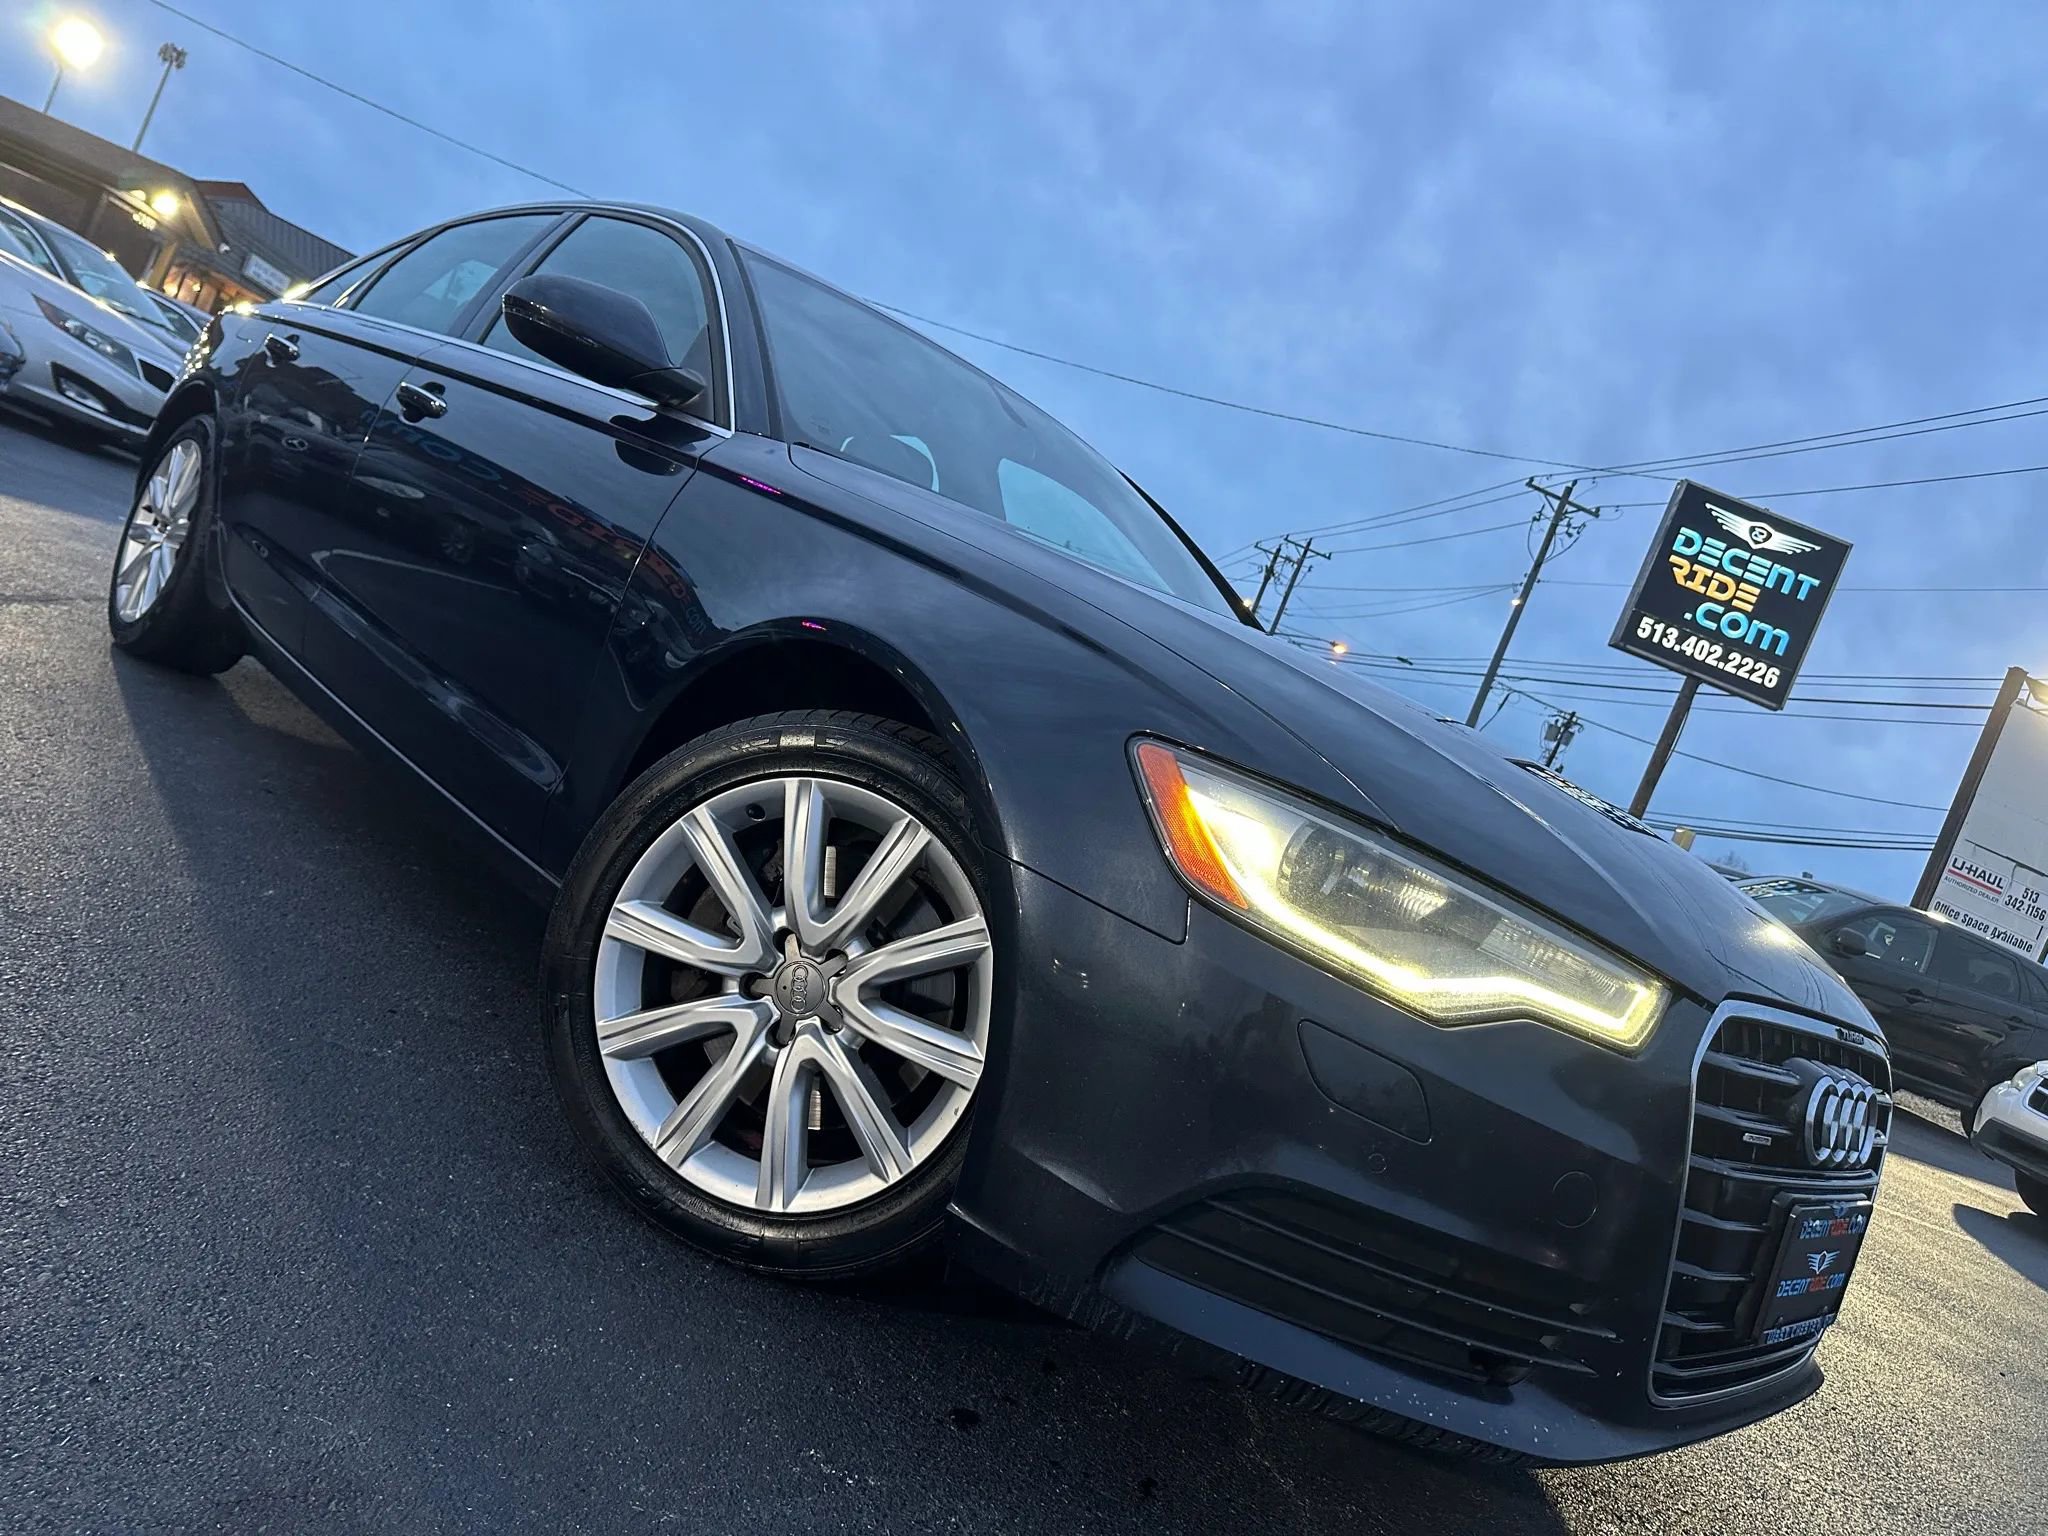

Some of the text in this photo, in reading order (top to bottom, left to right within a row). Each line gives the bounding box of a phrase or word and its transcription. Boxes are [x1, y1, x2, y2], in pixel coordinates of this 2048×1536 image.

[1672, 526, 1820, 600] DECENT
[1668, 554, 1761, 612] RIDE
[1636, 616, 1781, 689] 513.402.2226
[1943, 875, 2000, 904] AUTHORIZED DEALER
[1951, 857, 2004, 890] U-HAUL
[2022, 887, 2040, 904] 513
[1933, 900, 1961, 920] Office
[1961, 913, 1989, 933] Space
